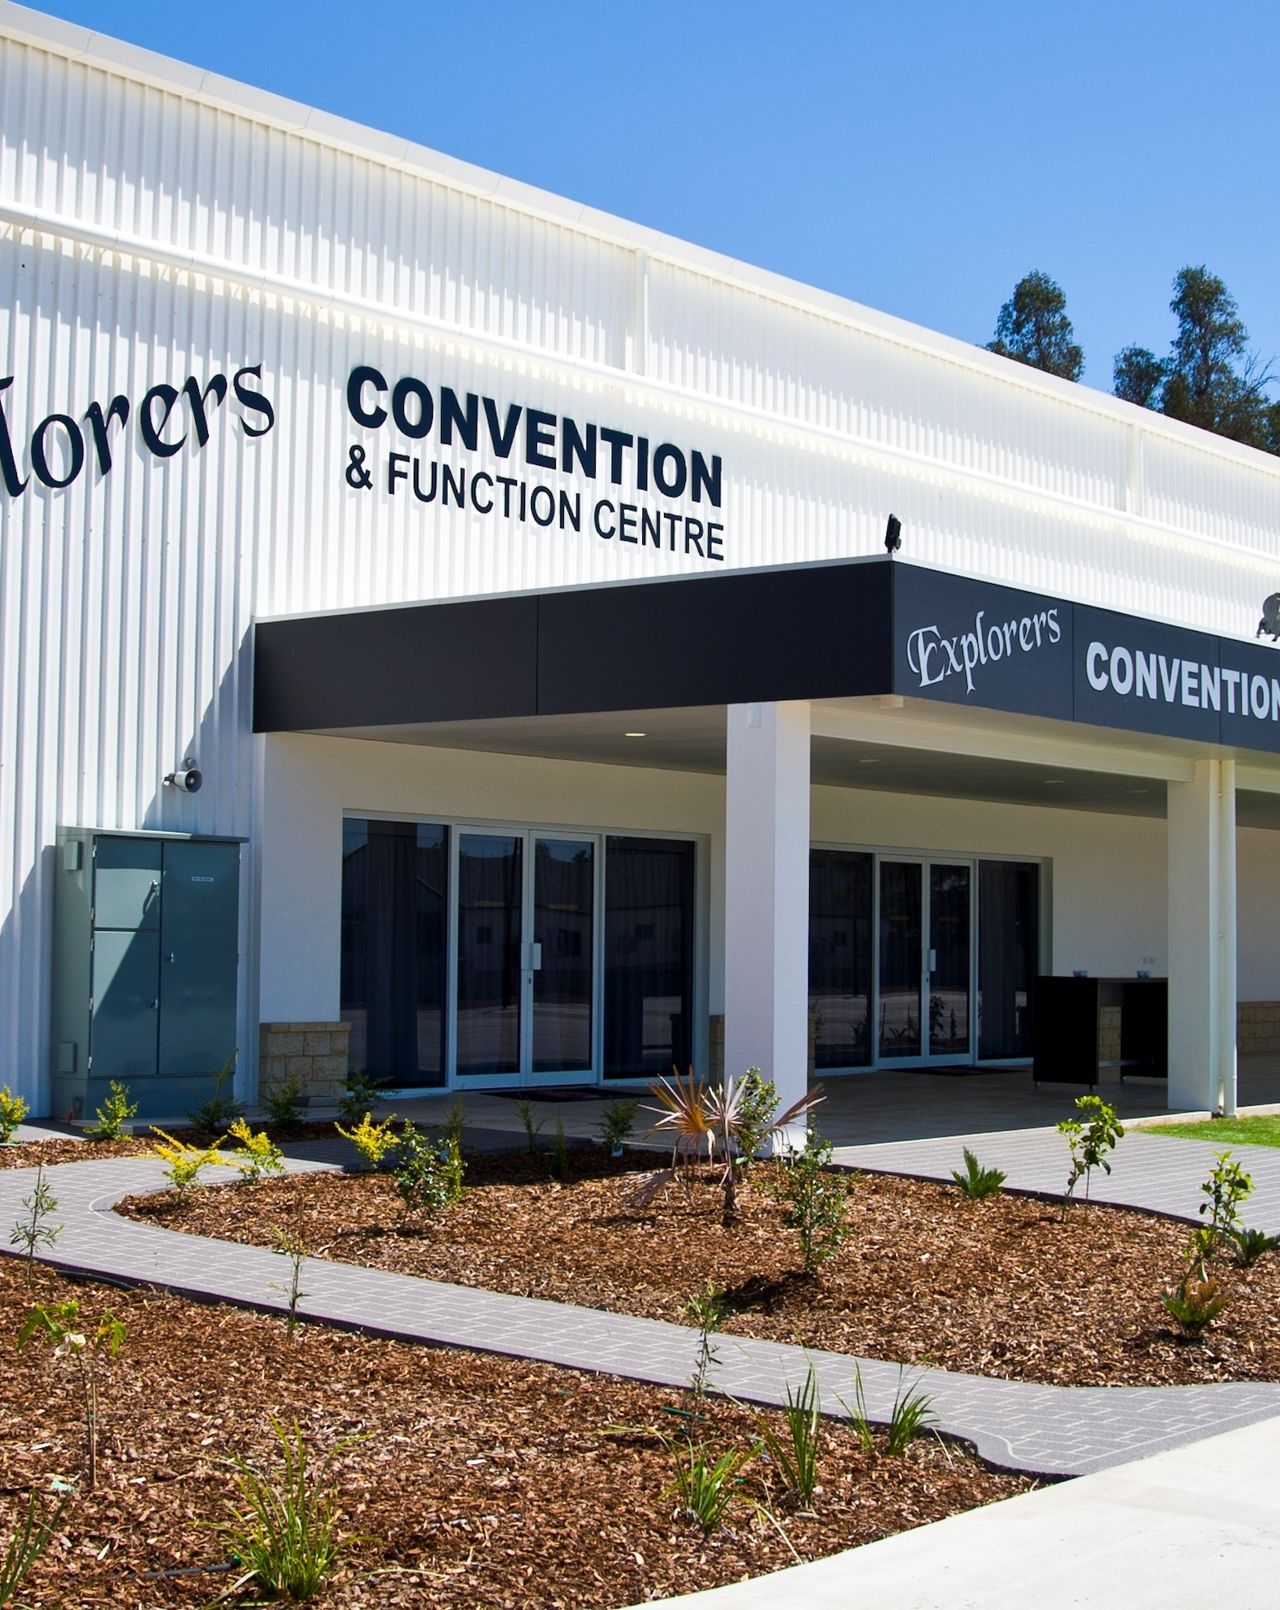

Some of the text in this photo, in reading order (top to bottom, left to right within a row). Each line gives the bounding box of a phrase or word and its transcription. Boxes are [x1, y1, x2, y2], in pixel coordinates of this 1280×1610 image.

[346, 366, 723, 508] CONVENTION
[346, 444, 725, 562] & FUNCTION CENTRE
[907, 608, 1061, 695] Explorers
